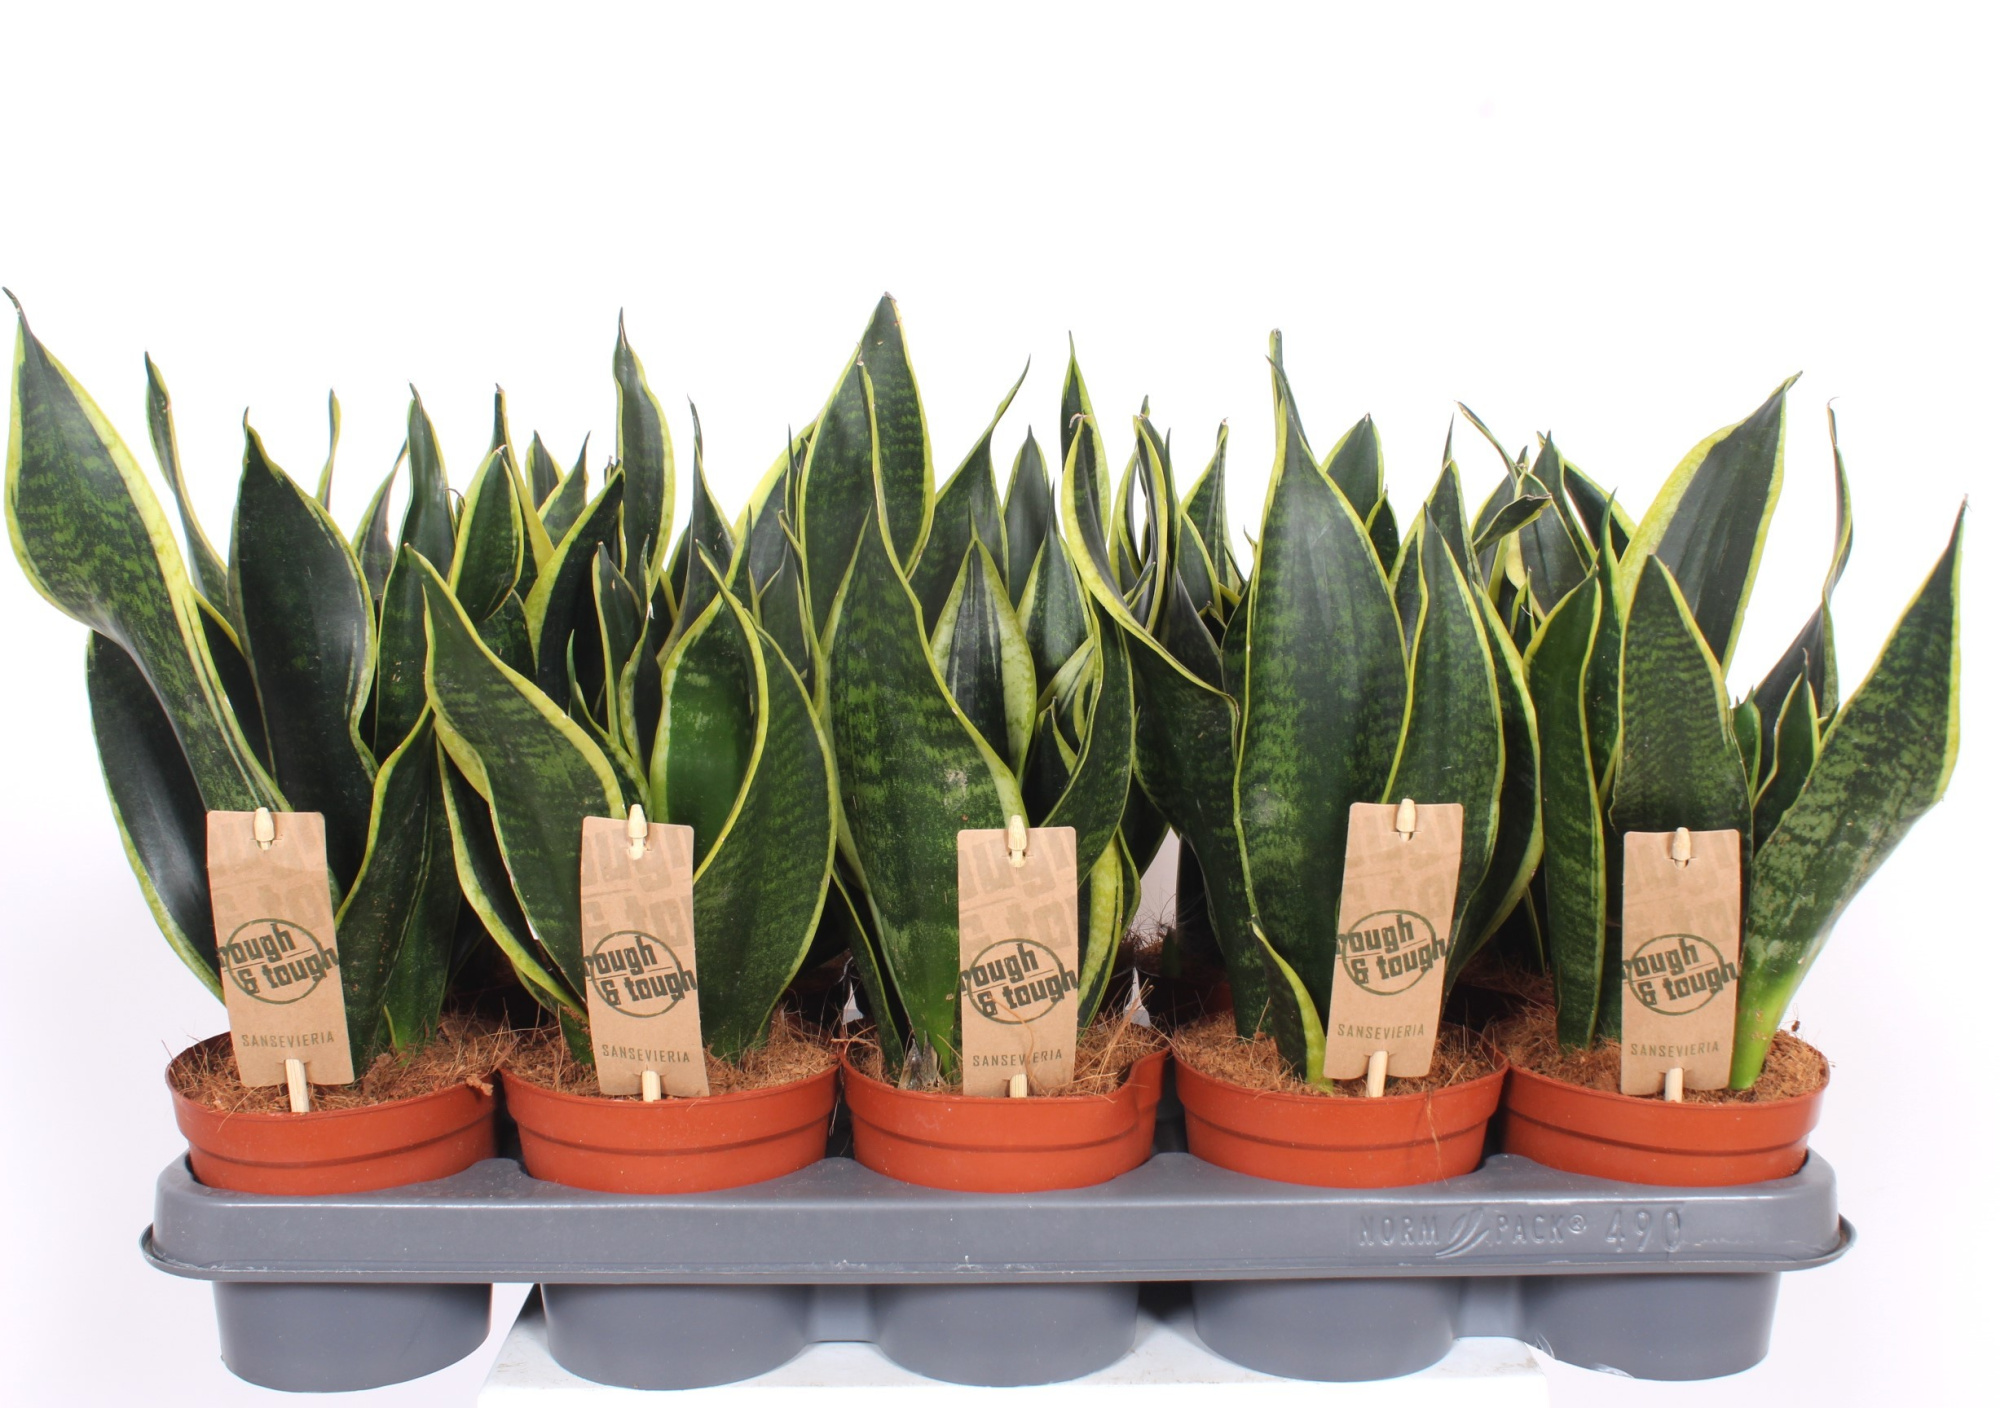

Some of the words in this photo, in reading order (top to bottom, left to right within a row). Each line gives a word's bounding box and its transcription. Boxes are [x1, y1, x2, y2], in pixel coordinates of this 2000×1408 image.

[217, 923, 296, 967] rough
[1336, 914, 1414, 954] rough
[237, 968, 260, 994] &
[261, 942, 339, 990] tough
[583, 935, 658, 976] rough
[961, 943, 1039, 992] rough
[1351, 958, 1369, 984] &
[1376, 932, 1446, 980] tough
[1622, 938, 1700, 979] rough
[600, 980, 621, 1005] &
[624, 961, 697, 1001] tough
[977, 991, 998, 1017] &
[1002, 962, 1078, 1009] tough
[1638, 981, 1657, 1005] &
[1663, 956, 1737, 1000] tough
[241, 1030, 335, 1048] SANSEVIERIA
[1337, 1023, 1424, 1040] SANSEVIERIA
[1630, 1041, 1719, 1058] SANSEVIERIA
[601, 1044, 690, 1063] SANSEVIERIA
[973, 1049, 1062, 1066] SANSEVERIA
[1359, 1214, 1440, 1246] NORM
[1605, 1208, 1682, 1253] 490
